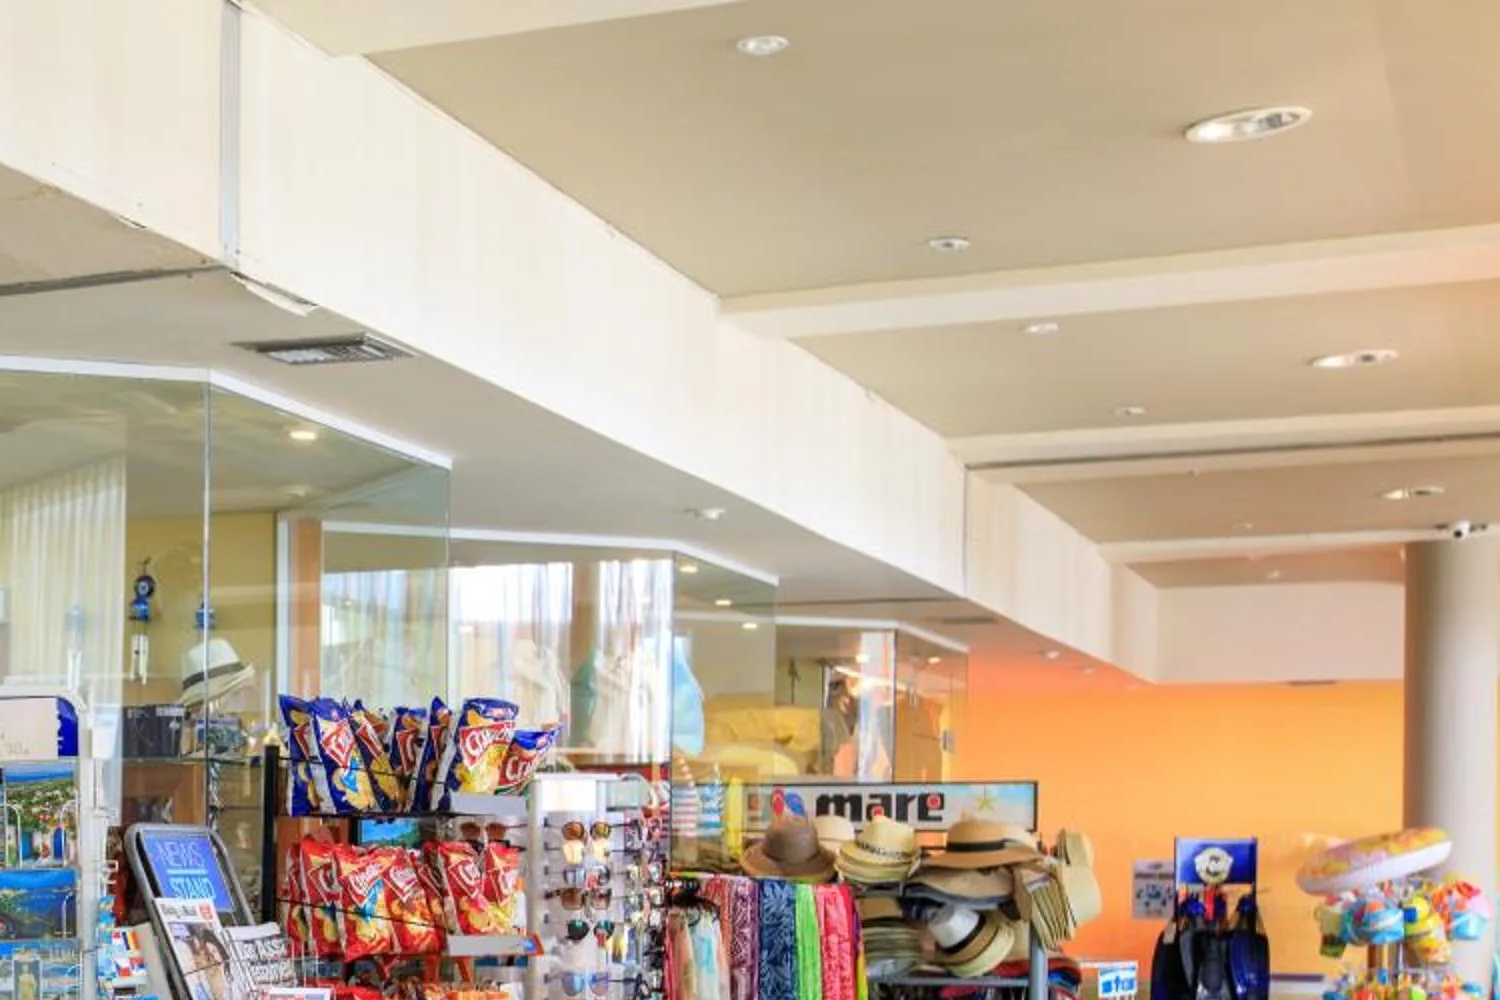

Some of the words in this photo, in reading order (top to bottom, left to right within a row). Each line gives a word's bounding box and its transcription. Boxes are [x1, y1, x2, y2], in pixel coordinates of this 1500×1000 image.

[816, 792, 944, 823] mare
[155, 841, 206, 869] NEWS
[169, 877, 216, 900] STAND
